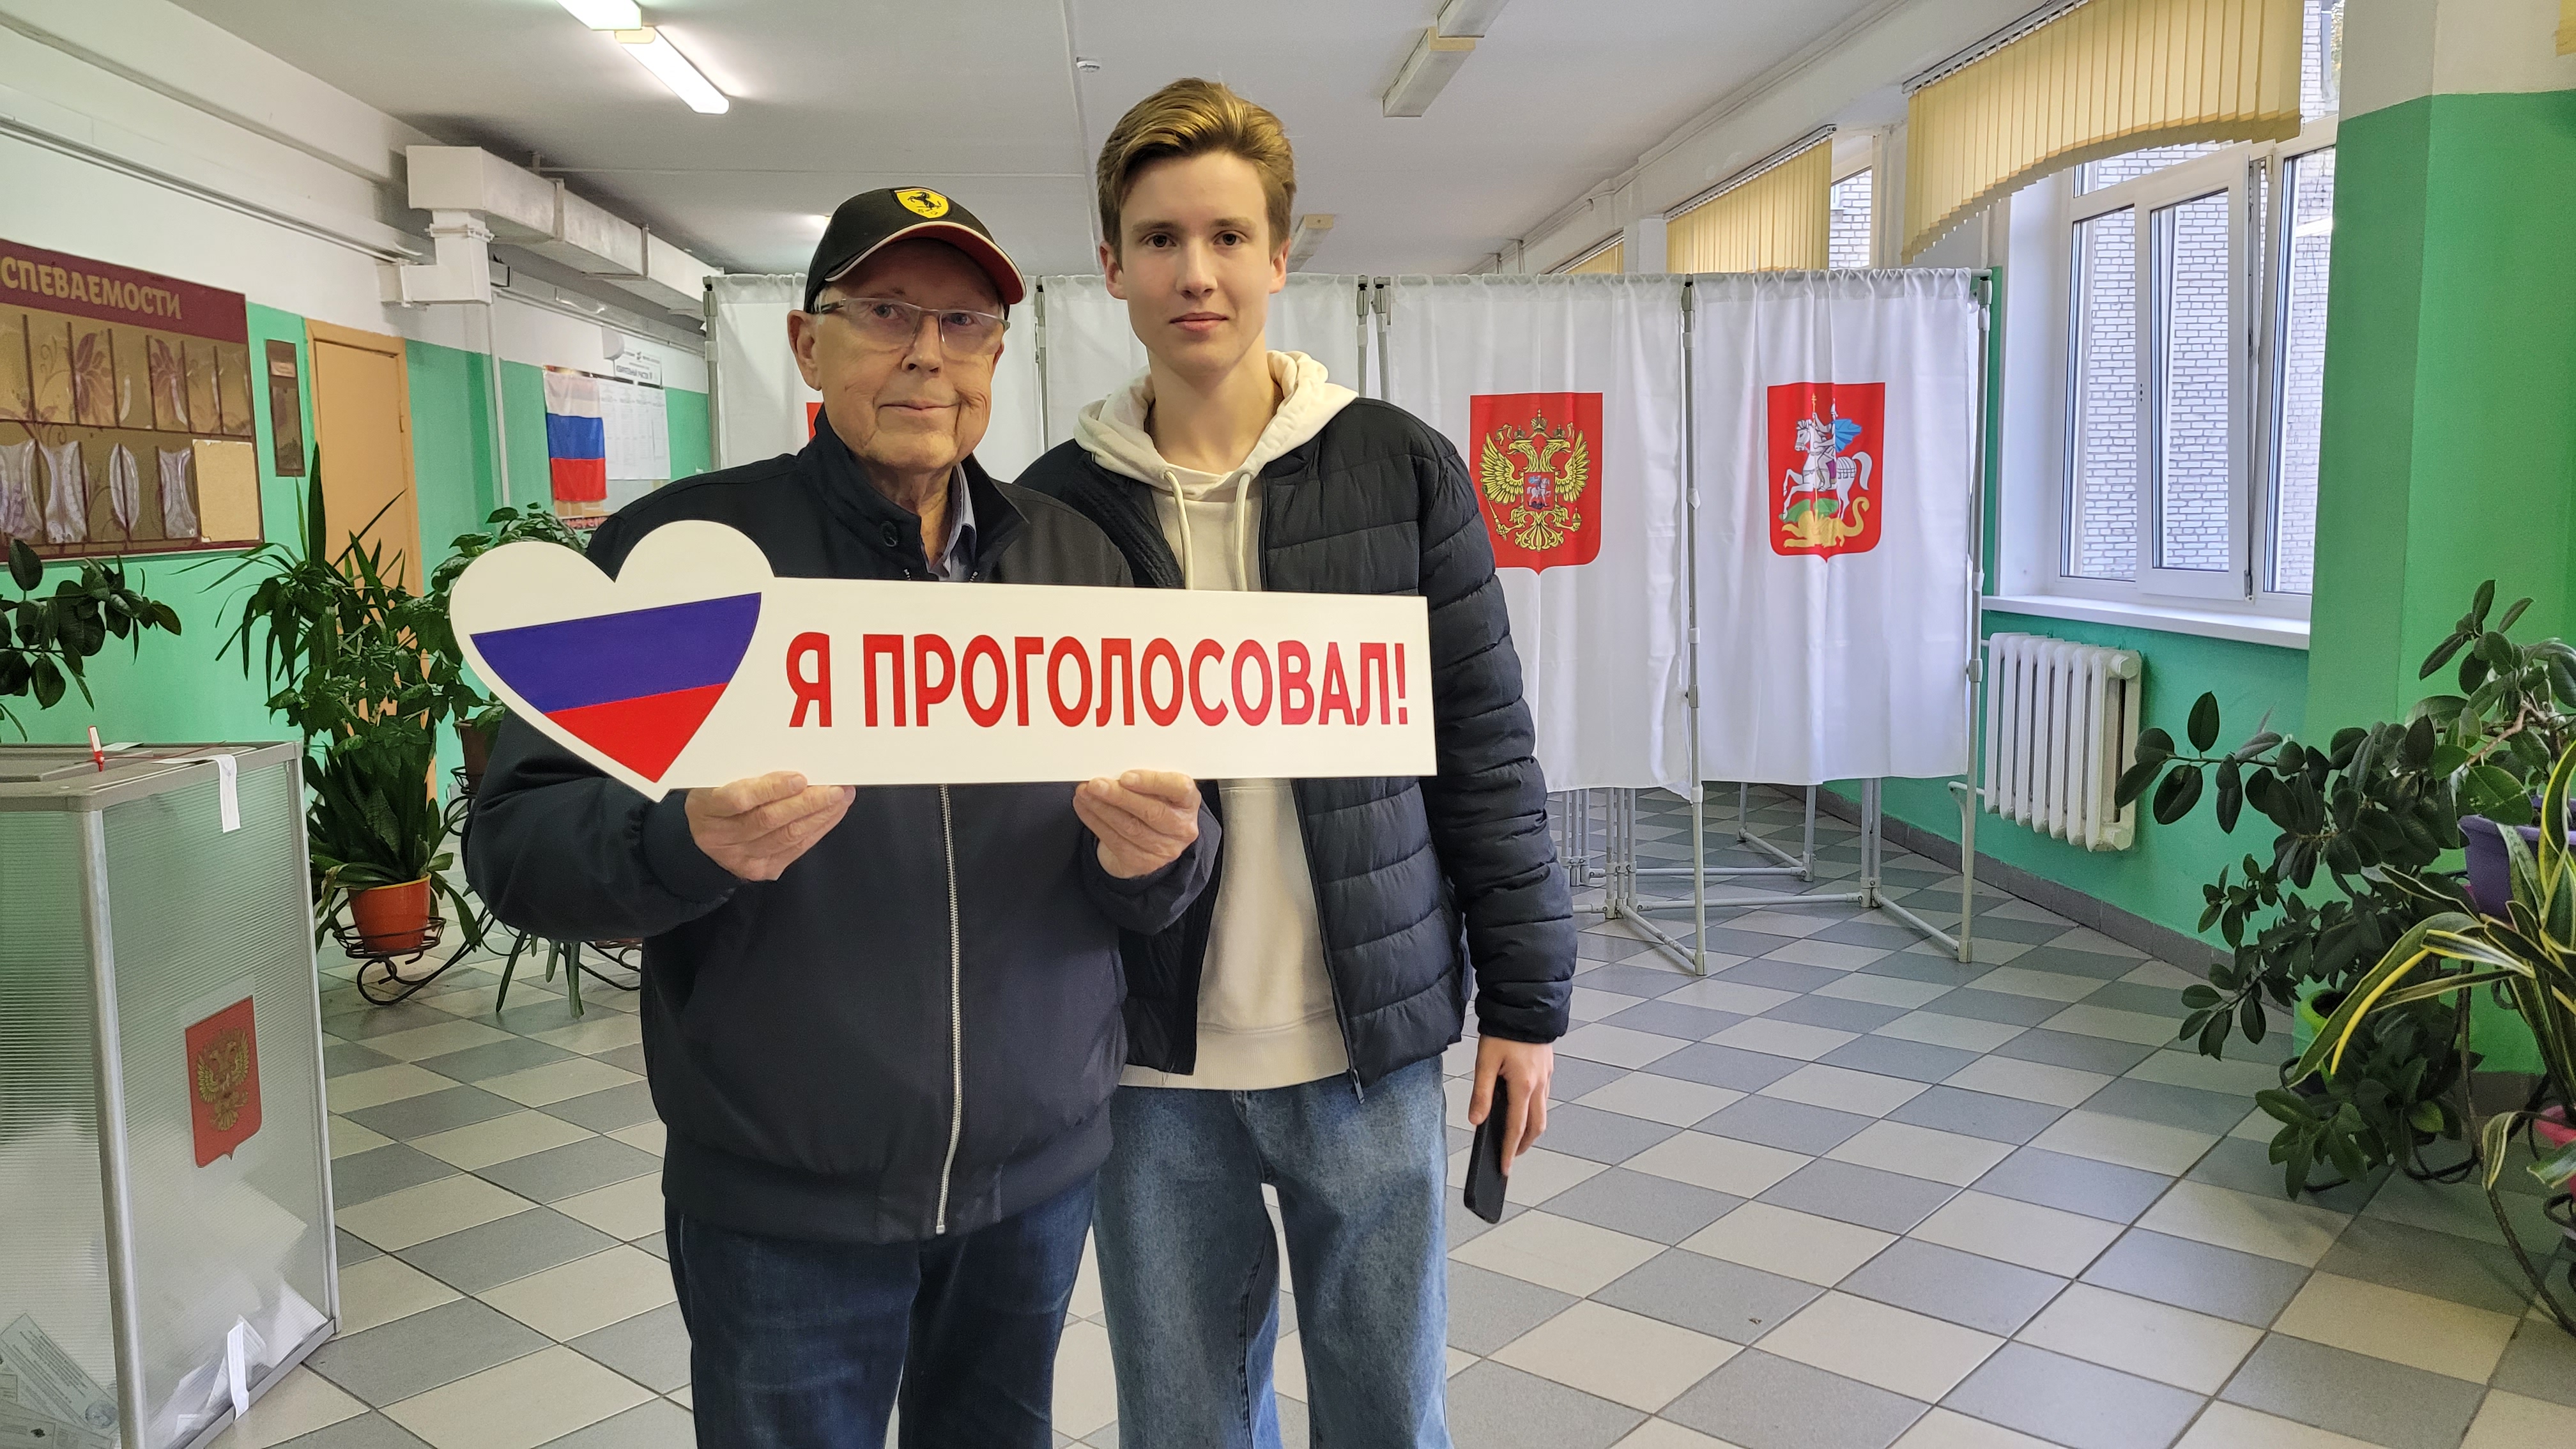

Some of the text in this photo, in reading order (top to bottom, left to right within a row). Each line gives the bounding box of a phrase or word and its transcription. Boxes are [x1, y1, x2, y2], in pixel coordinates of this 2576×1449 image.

[0, 256, 182, 319] СПЕВАЕМОСТИ
[786, 632, 1408, 727] Я ПРОГОЛОСОВАЛ!
